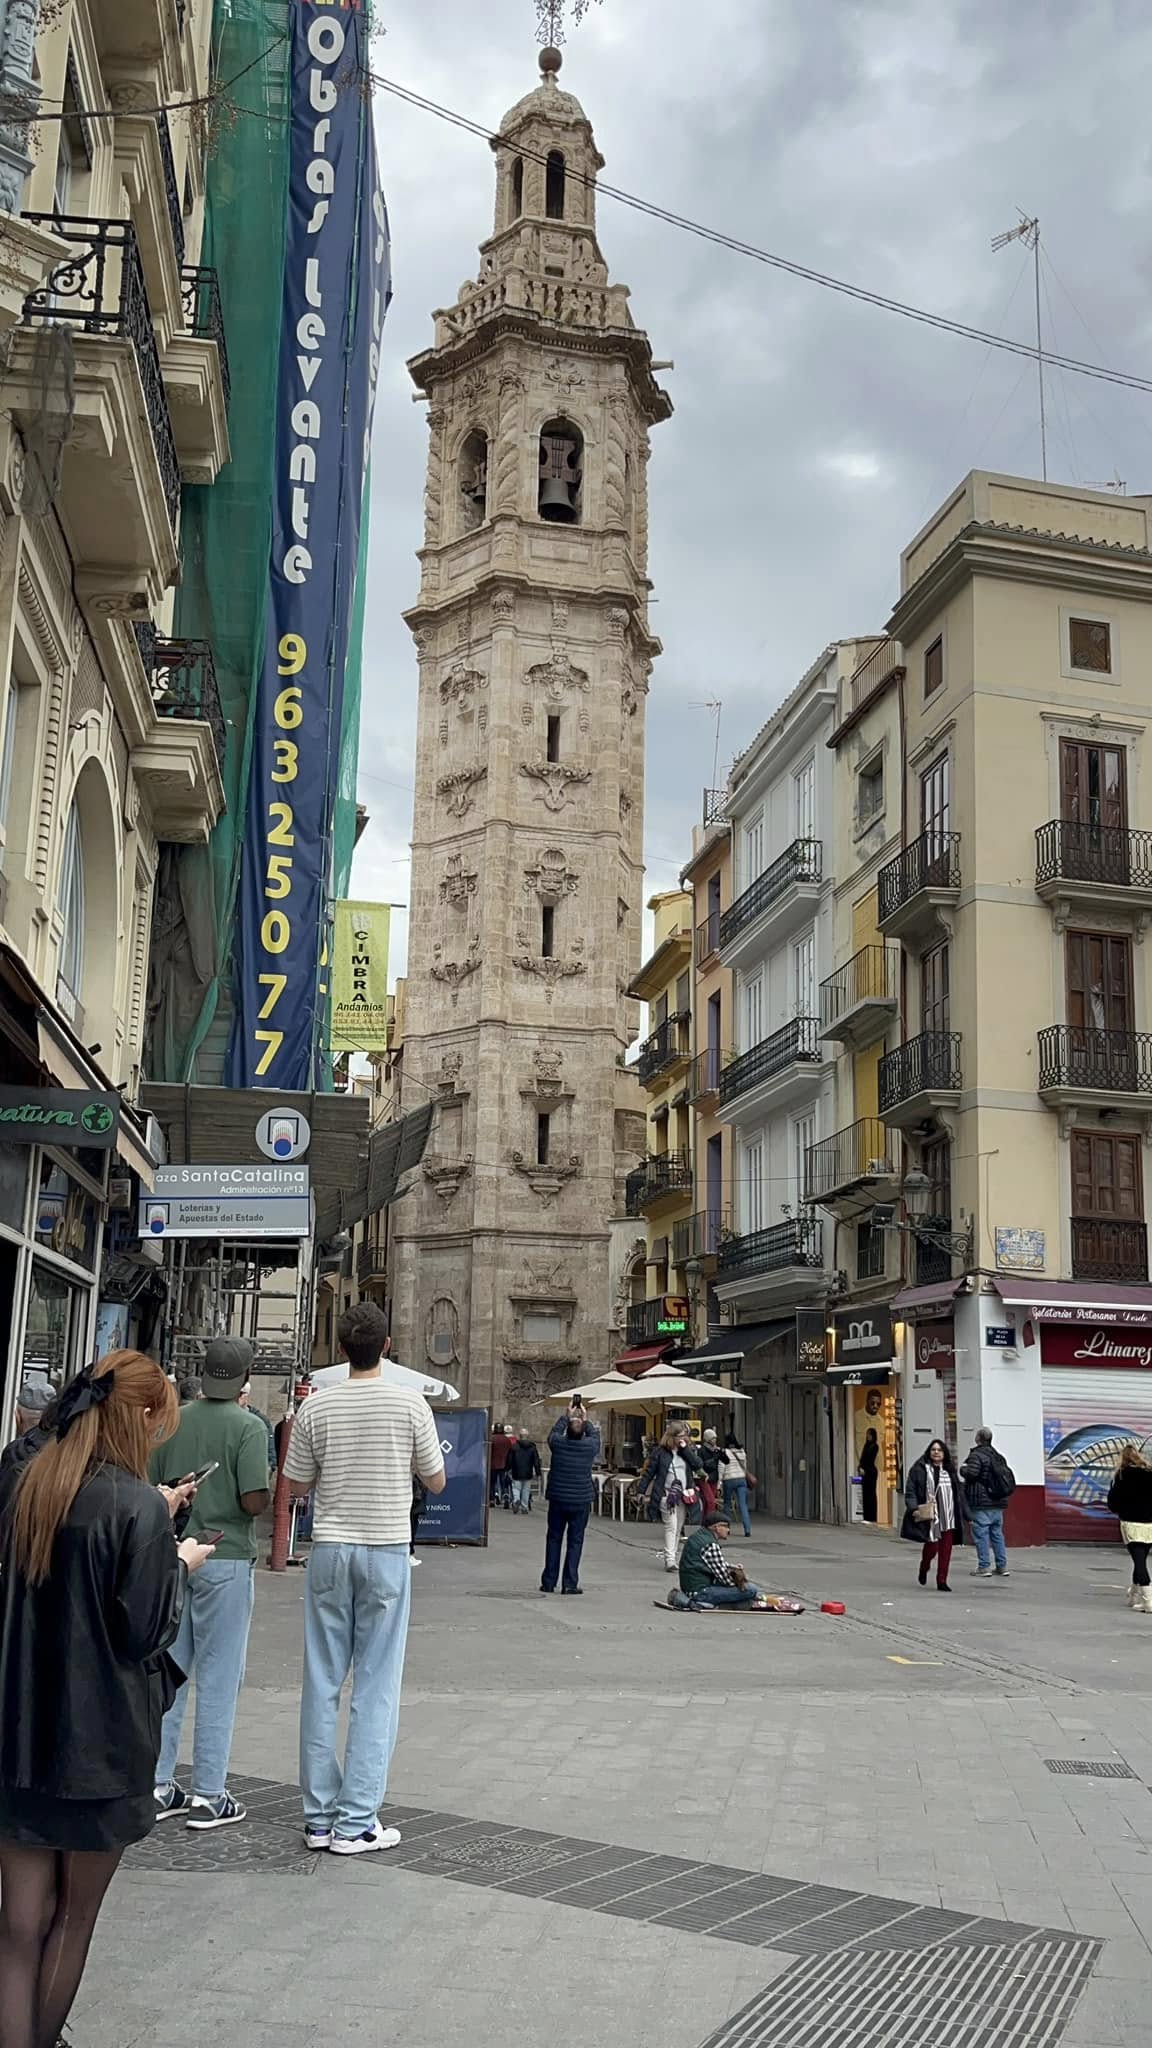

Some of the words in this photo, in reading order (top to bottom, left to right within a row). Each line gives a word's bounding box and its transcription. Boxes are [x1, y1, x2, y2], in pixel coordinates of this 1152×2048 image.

[306, 15, 345, 234] Obras
[271, 633, 307, 783] 963
[351, 930, 370, 1002] CIMBRA
[336, 1002, 384, 1011] Andamios
[252, 973, 287, 1089] 77
[0, 1103, 79, 1126] atura
[153, 1173, 178, 1183] aza
[181, 1169, 305, 1183] SantaCatalina
[220, 1185, 282, 1194] Administración
[216, 1205, 221, 1213] y
[179, 1214, 218, 1224] Apuestas
[220, 1214, 233, 1222] del
[235, 1213, 264, 1222] Estado
[799, 1341, 824, 1354] Hotel
